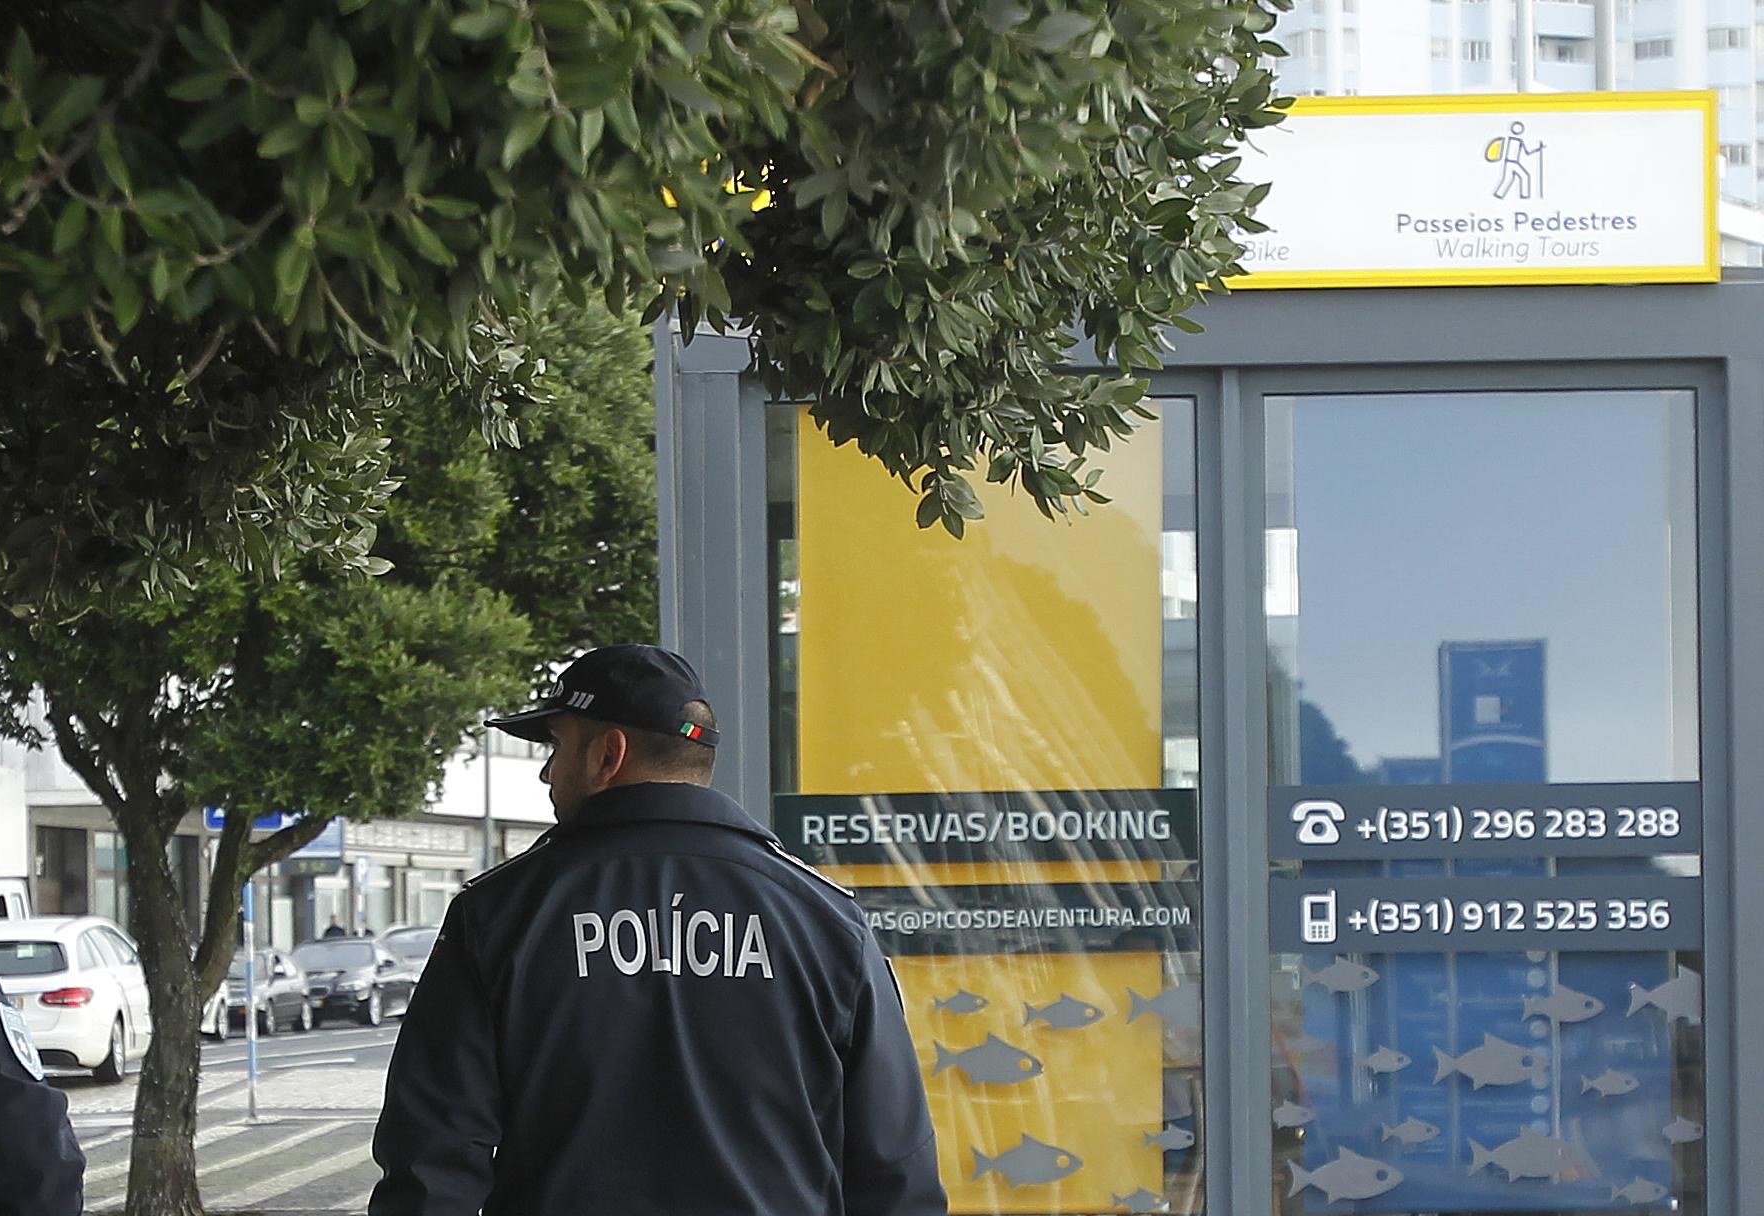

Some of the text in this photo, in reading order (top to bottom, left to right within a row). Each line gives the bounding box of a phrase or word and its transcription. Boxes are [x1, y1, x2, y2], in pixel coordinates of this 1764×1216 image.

[1396, 210, 1637, 234] Passeios Pedestres
[1435, 236, 1600, 263] Walking Tours
[802, 810, 1171, 845] RESERVAS/BOOKING
[1356, 806, 1680, 844] +(351) 296 283 288
[1348, 898, 1670, 936] +(351) 912 525 356
[572, 892, 774, 979] POLÍCIA
